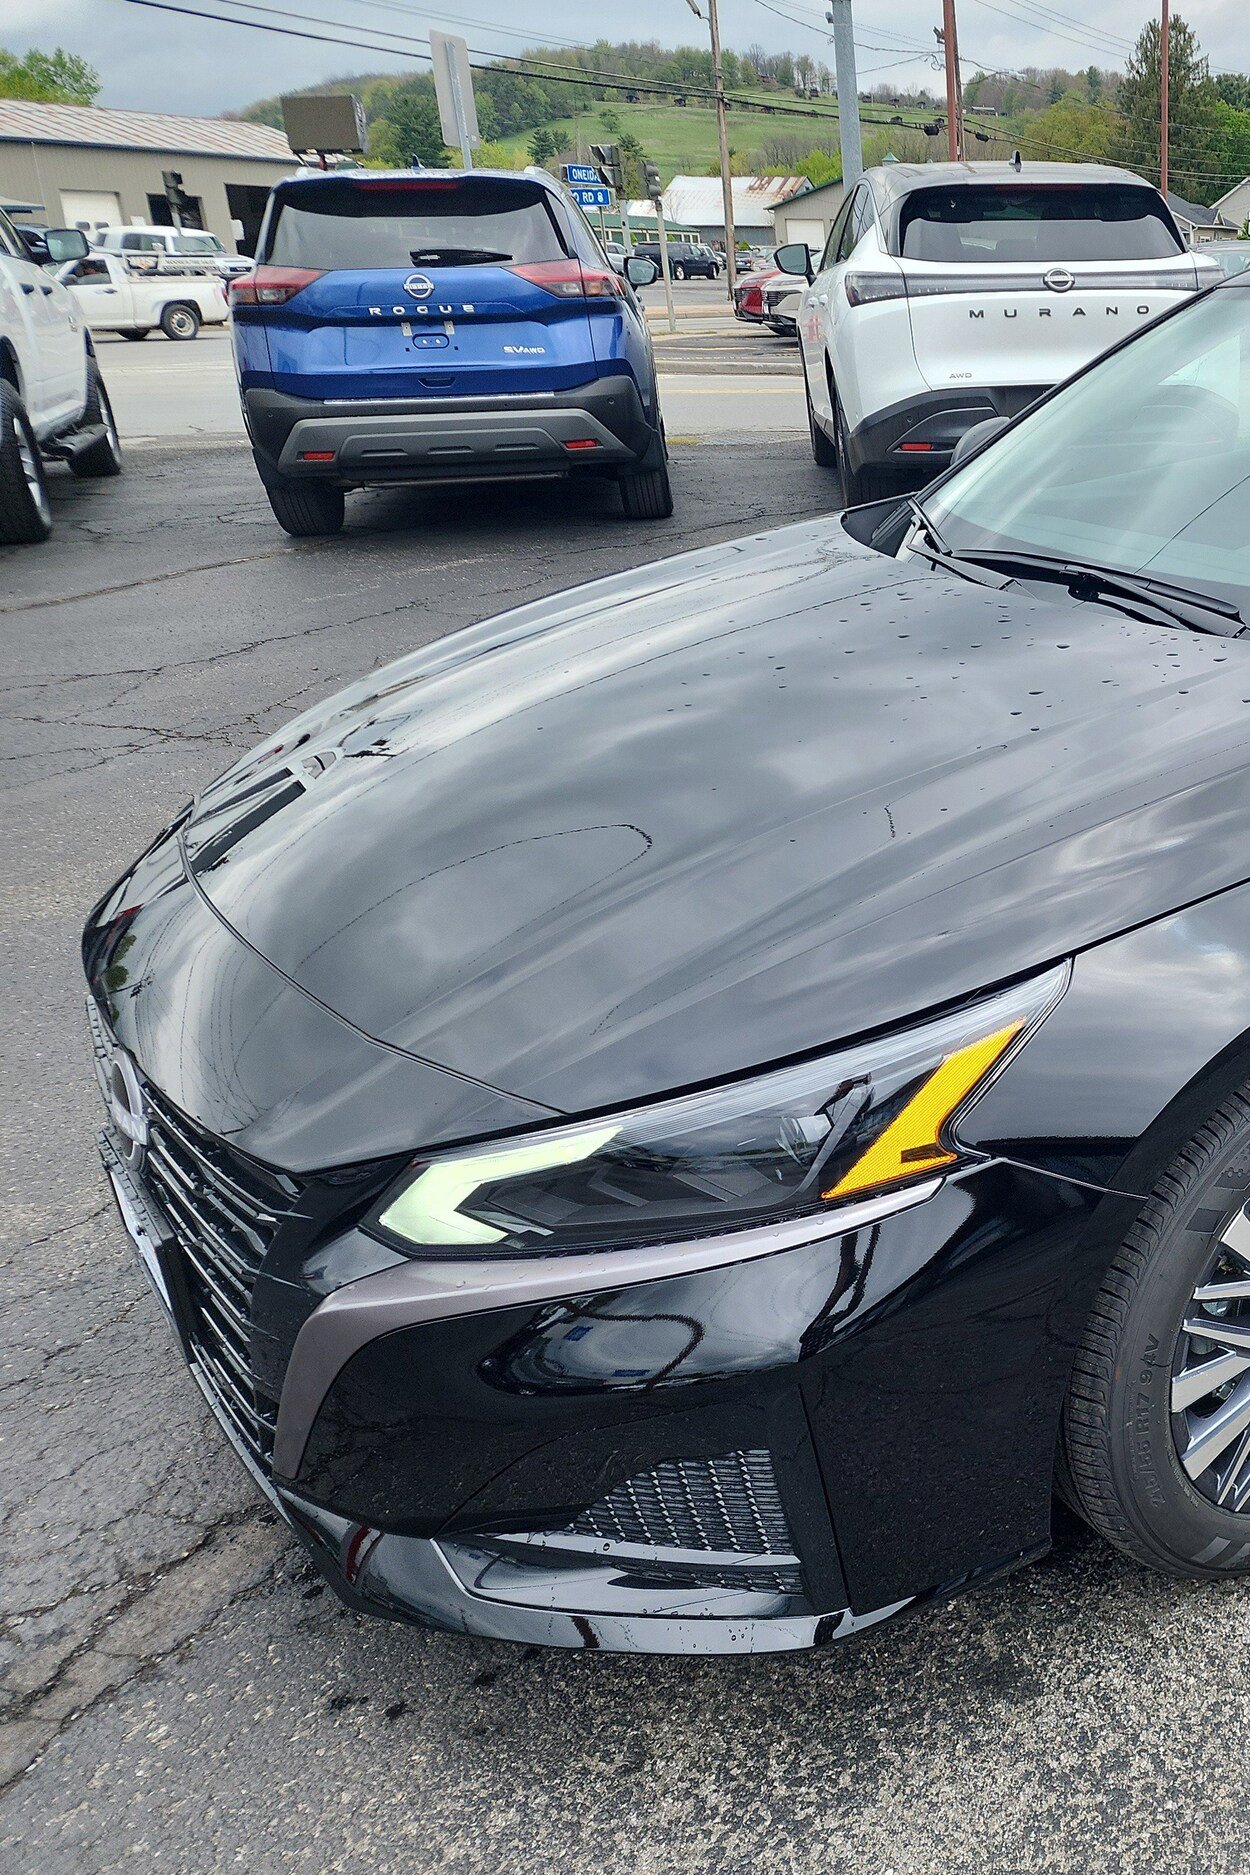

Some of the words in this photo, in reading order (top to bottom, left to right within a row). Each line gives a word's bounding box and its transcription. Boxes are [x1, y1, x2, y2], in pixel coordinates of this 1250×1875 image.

[582, 191, 594, 203] RD
[597, 192, 604, 203] 8
[368, 304, 475, 316] ROGUE
[968, 305, 1150, 319] MURANO
[1135, 1391, 1150, 1436] R17
